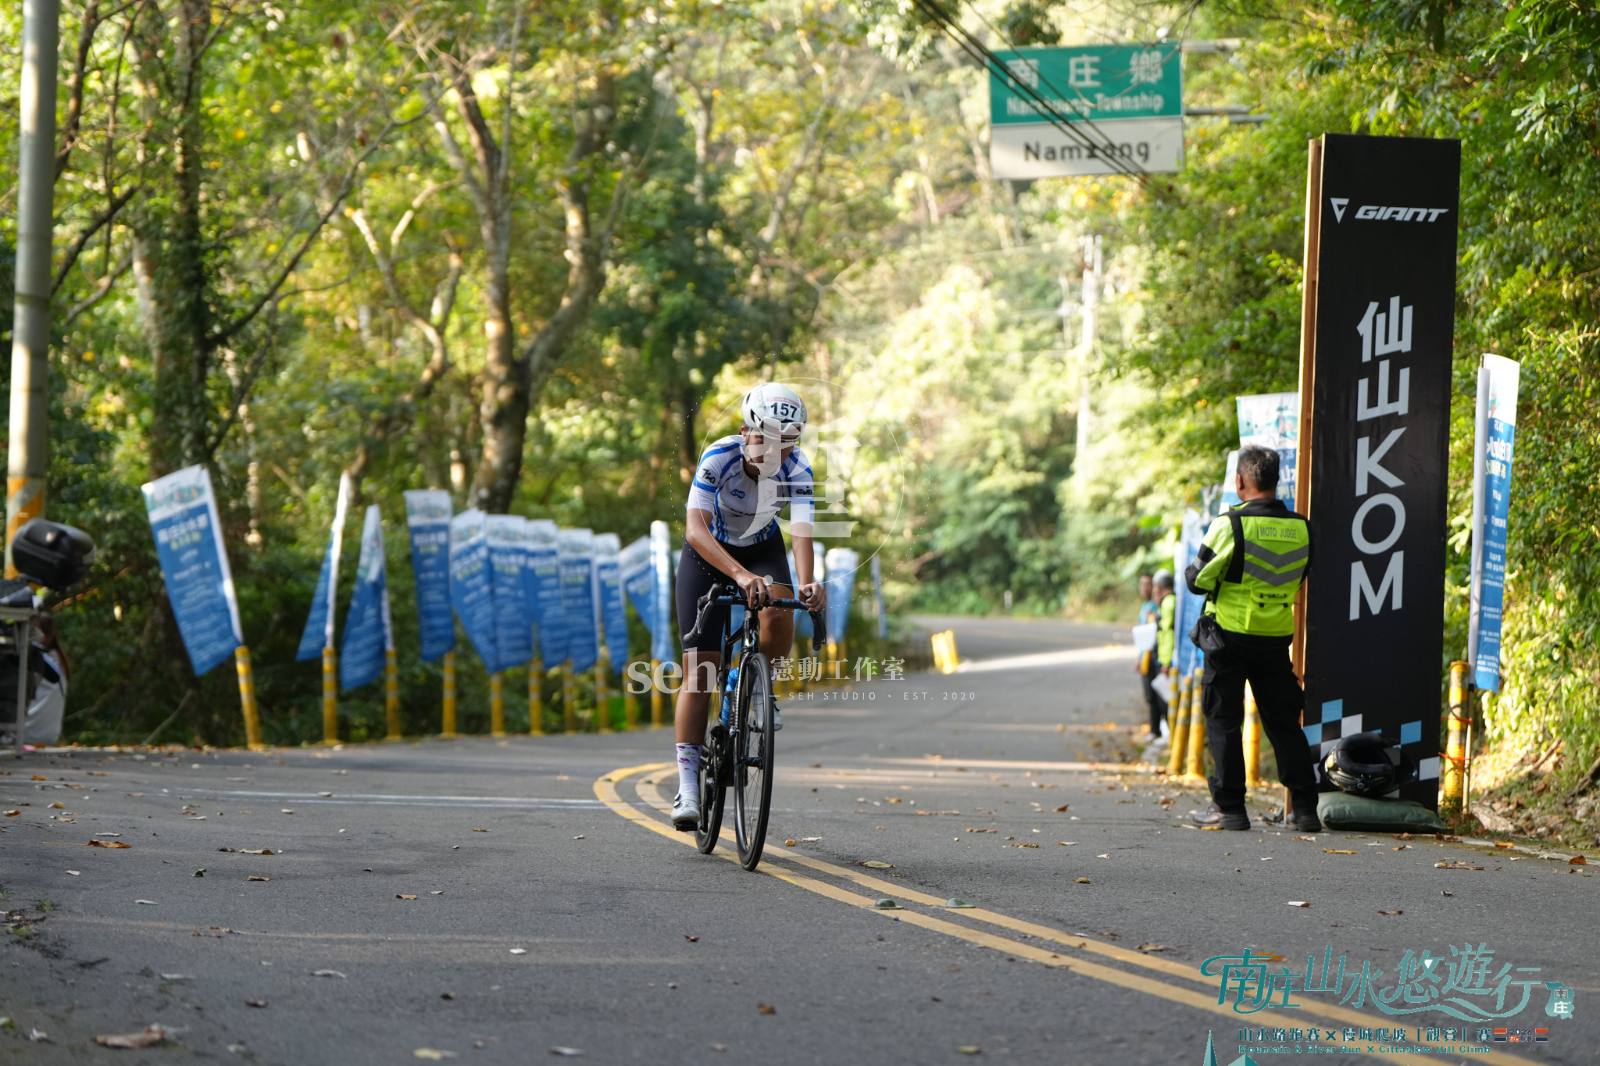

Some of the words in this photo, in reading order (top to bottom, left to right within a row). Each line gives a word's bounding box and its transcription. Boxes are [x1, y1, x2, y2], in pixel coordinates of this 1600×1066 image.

[1354, 205, 1449, 223] GIANT
[770, 402, 798, 419] 157
[1260, 526, 1277, 537] MOTO
[1279, 527, 1297, 539] JUDGE
